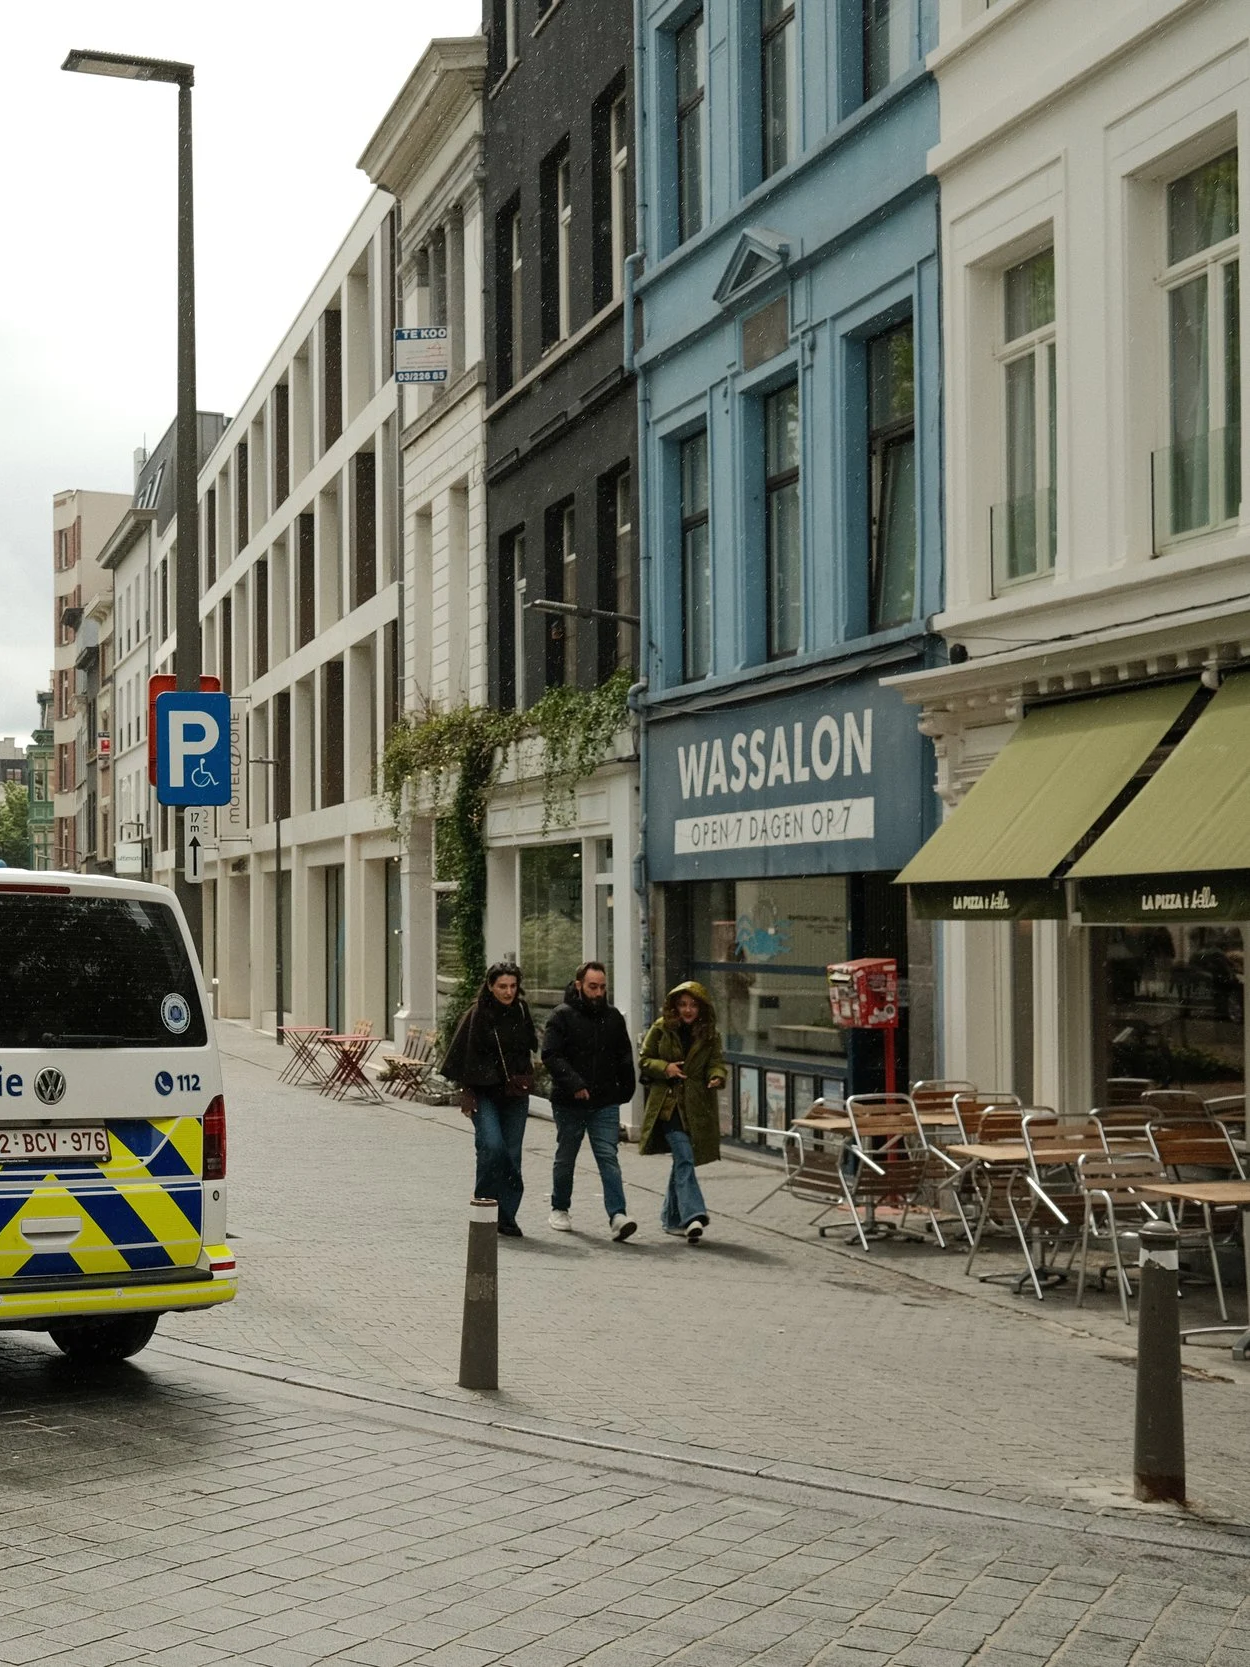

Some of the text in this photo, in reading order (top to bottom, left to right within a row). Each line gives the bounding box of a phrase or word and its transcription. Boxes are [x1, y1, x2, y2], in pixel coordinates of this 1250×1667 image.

[402, 329, 447, 339] TE KOO
[168, 710, 220, 788] P
[678, 708, 873, 800] WASSALON
[190, 812, 200, 823] 17
[691, 806, 852, 847] OPEN 7 DAGEN OP 7
[953, 896, 962, 909] LA
[963, 895, 984, 909] PIZZA
[1142, 894, 1154, 910] LA
[1155, 893, 1182, 910] PIZZA
[177, 1074, 201, 1092] 112
